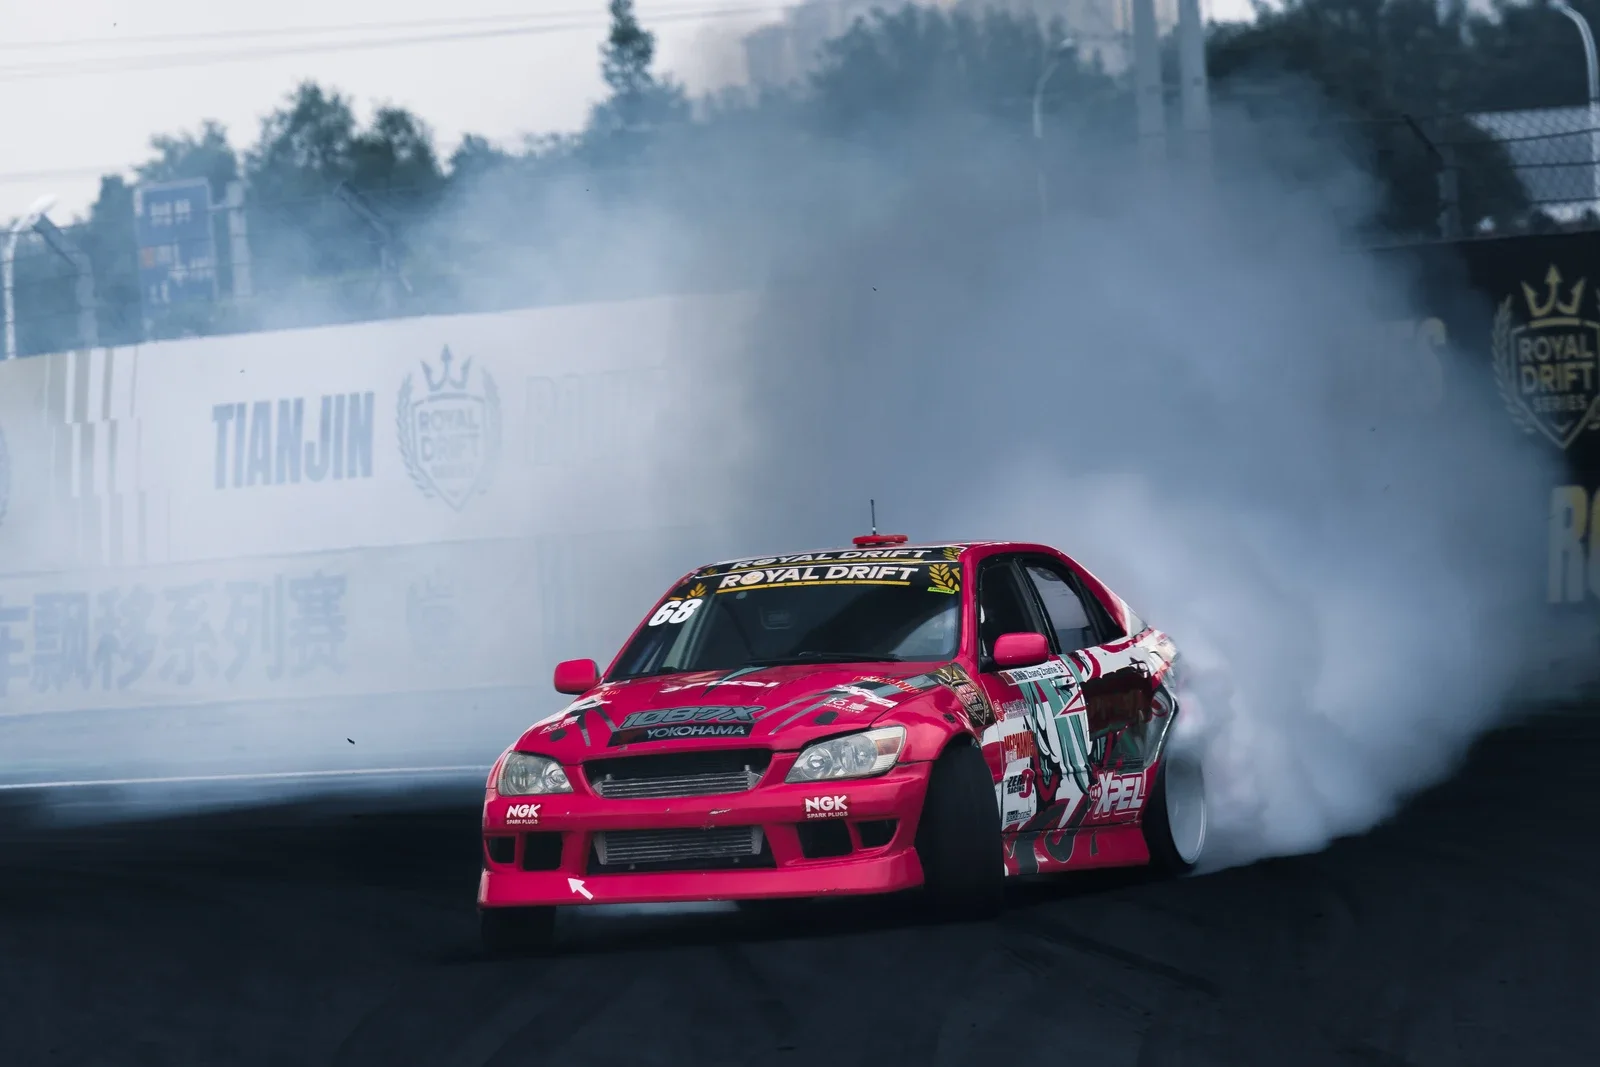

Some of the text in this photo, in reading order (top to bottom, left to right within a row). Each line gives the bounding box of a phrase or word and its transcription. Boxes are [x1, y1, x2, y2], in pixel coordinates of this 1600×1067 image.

[1519, 334, 1594, 361] ROYAL
[1521, 361, 1594, 394] DRIFT
[1532, 394, 1587, 413] SERIES
[419, 406, 480, 433] ROYAL
[211, 391, 376, 490] TIANJIN
[420, 432, 480, 463] DRIFT
[731, 550, 931, 570] ROYAL DRIFT
[719, 564, 920, 588] ROYAL DRIFT
[648, 598, 703, 627] 68
[647, 725, 745, 739] YOKOHAMA
[805, 794, 848, 812] NGK
[1095, 772, 1143, 814] XPEL
[506, 804, 541, 818] NGK
